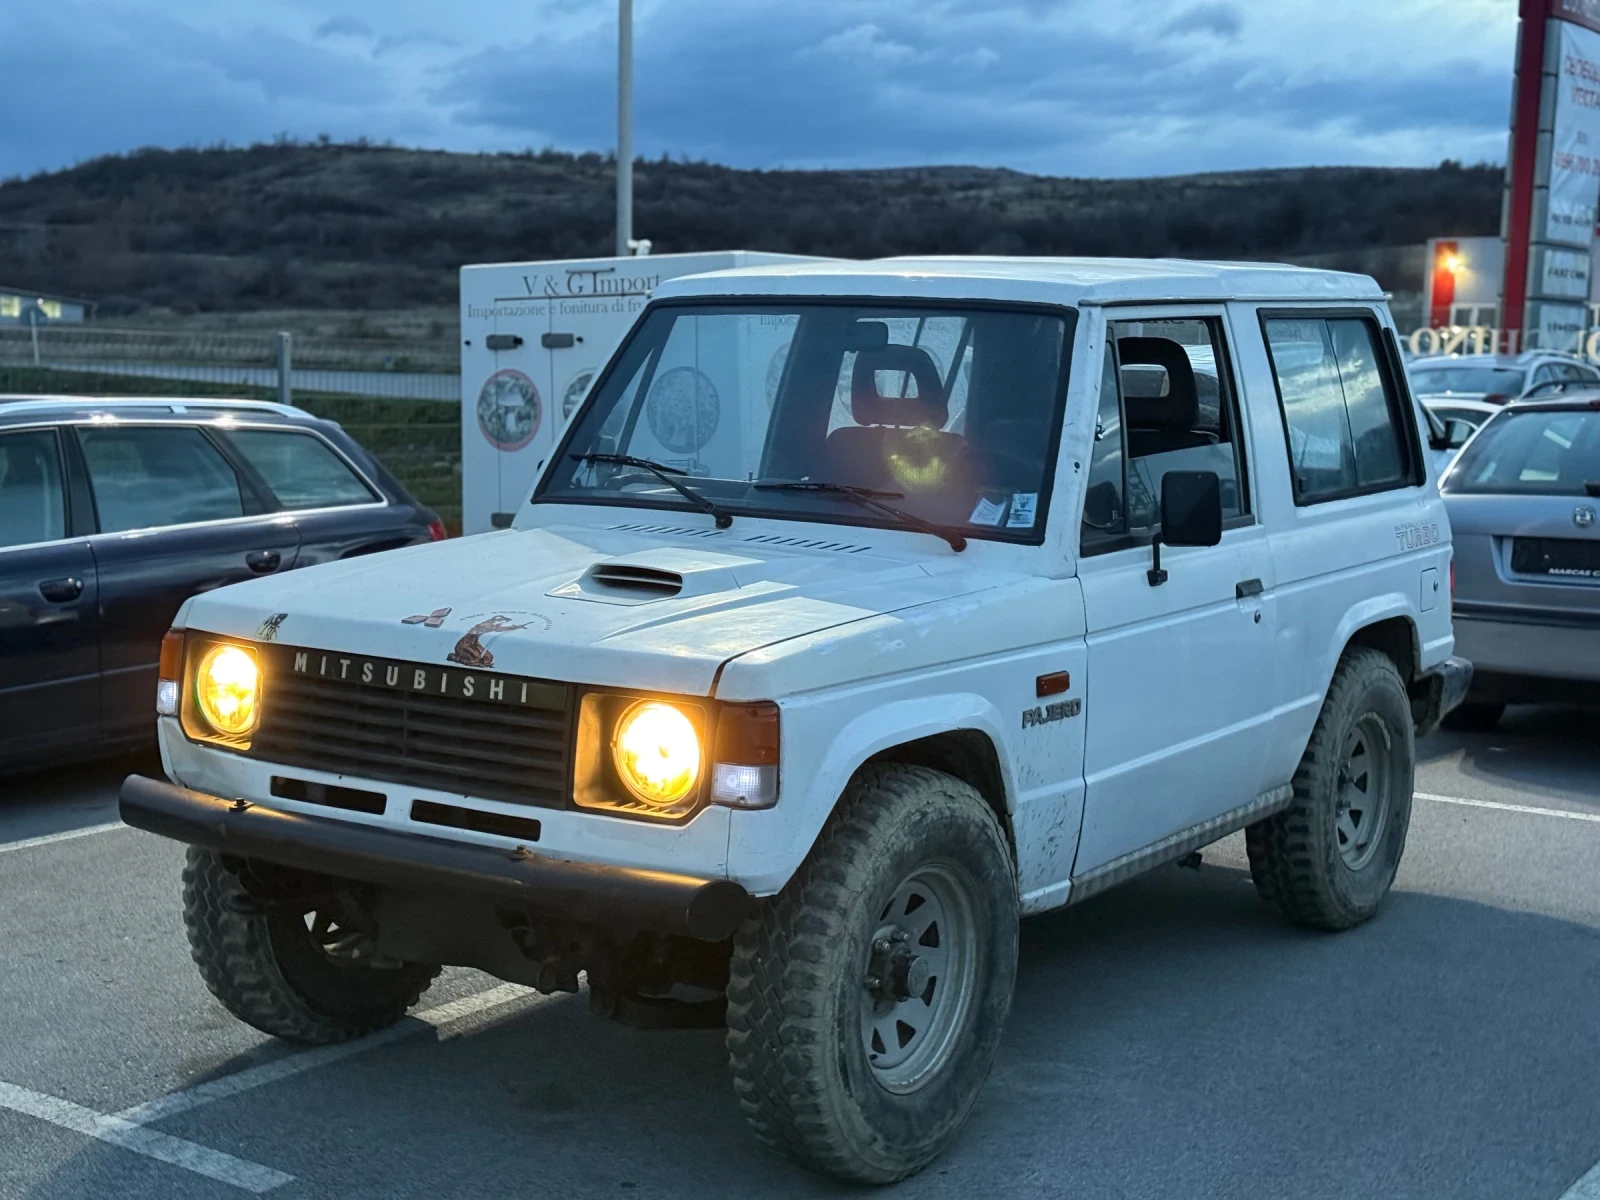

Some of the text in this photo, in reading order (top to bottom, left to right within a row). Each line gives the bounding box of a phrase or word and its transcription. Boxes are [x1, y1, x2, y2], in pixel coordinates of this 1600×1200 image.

[523, 271, 660, 297] V & G Import
[467, 303, 547, 320] Importazione
[611, 298, 624, 313] di
[1395, 523, 1440, 551] TURBO
[294, 652, 528, 703] MITSUBISHI
[1021, 697, 1082, 730] PAJERO
